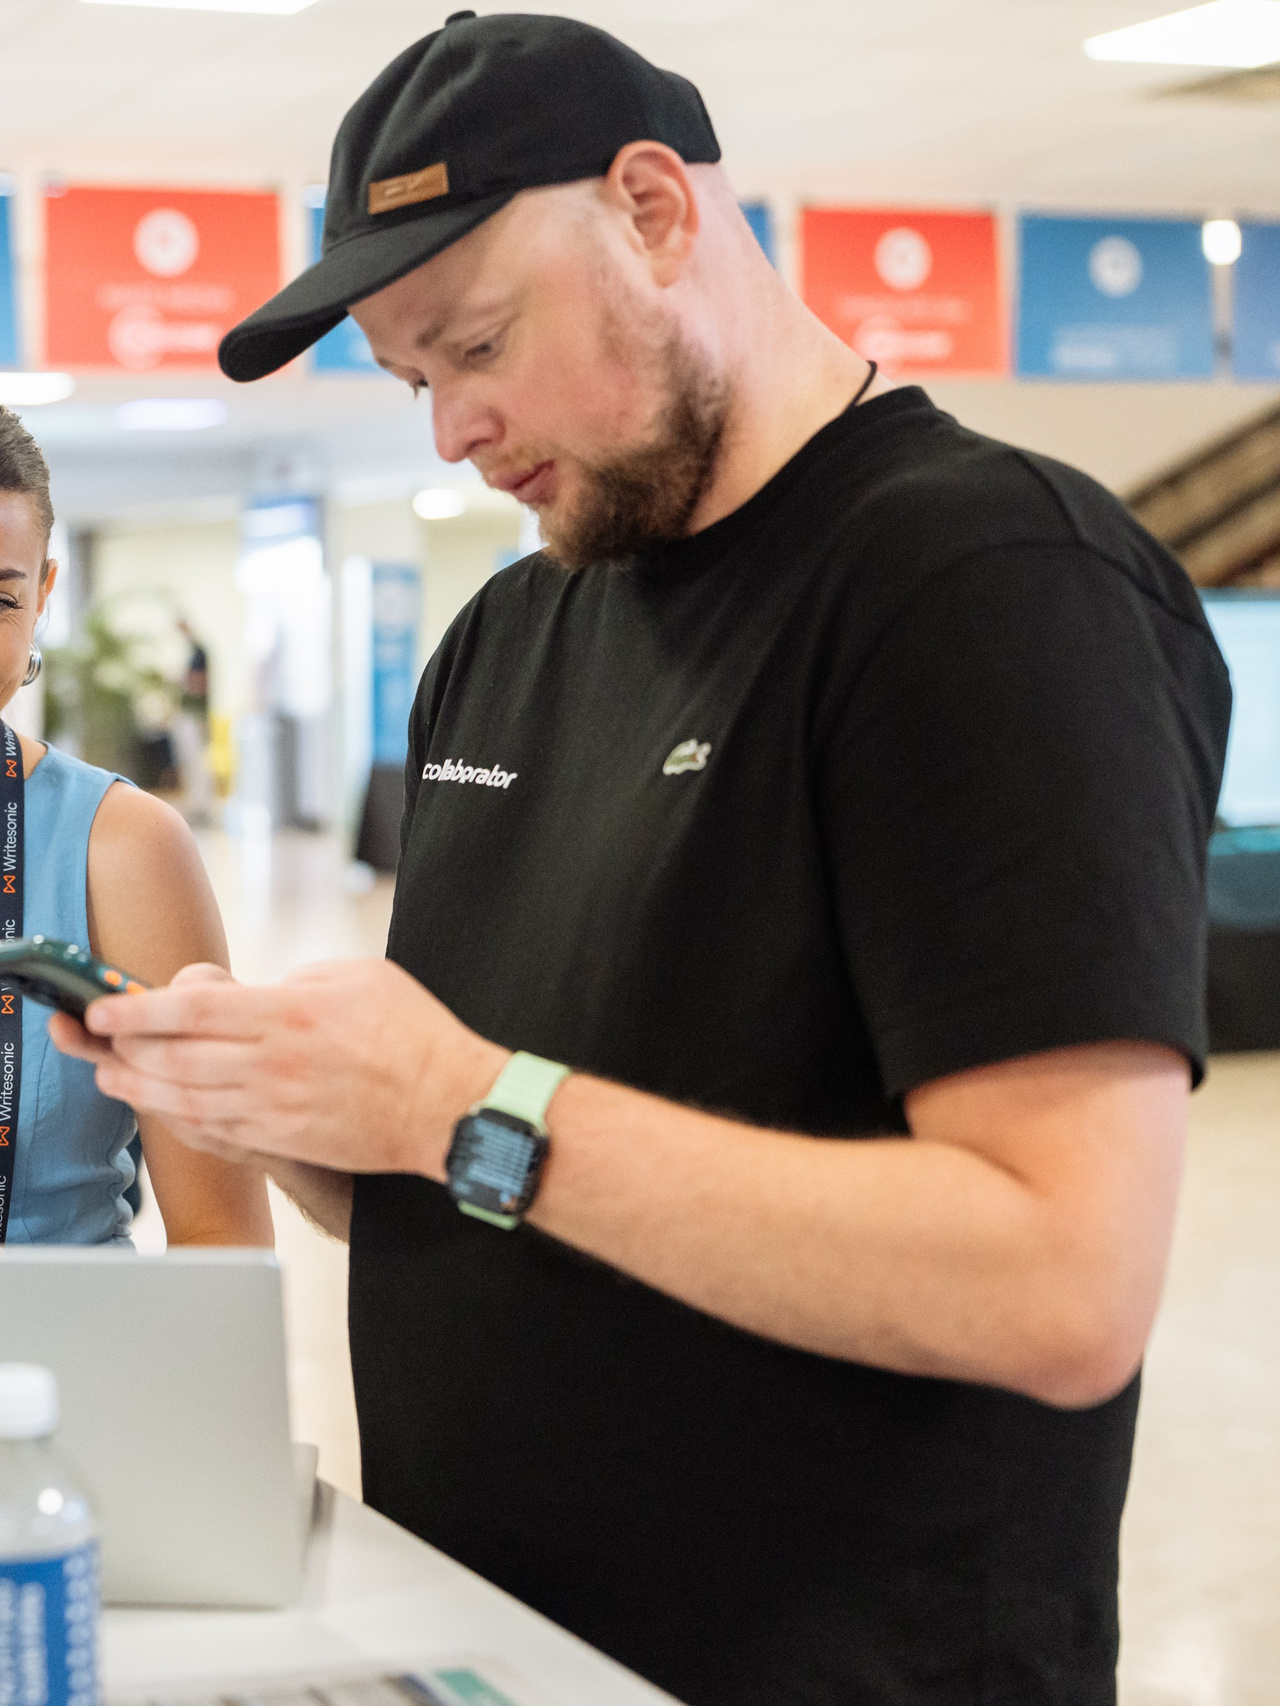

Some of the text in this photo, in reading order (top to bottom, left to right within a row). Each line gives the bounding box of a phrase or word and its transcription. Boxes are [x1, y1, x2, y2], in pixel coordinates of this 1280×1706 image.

[422, 759, 518, 789] collaborator
[3, 801, 17, 872] Writesonic
[0, 1042, 14, 1122] Writesonic
